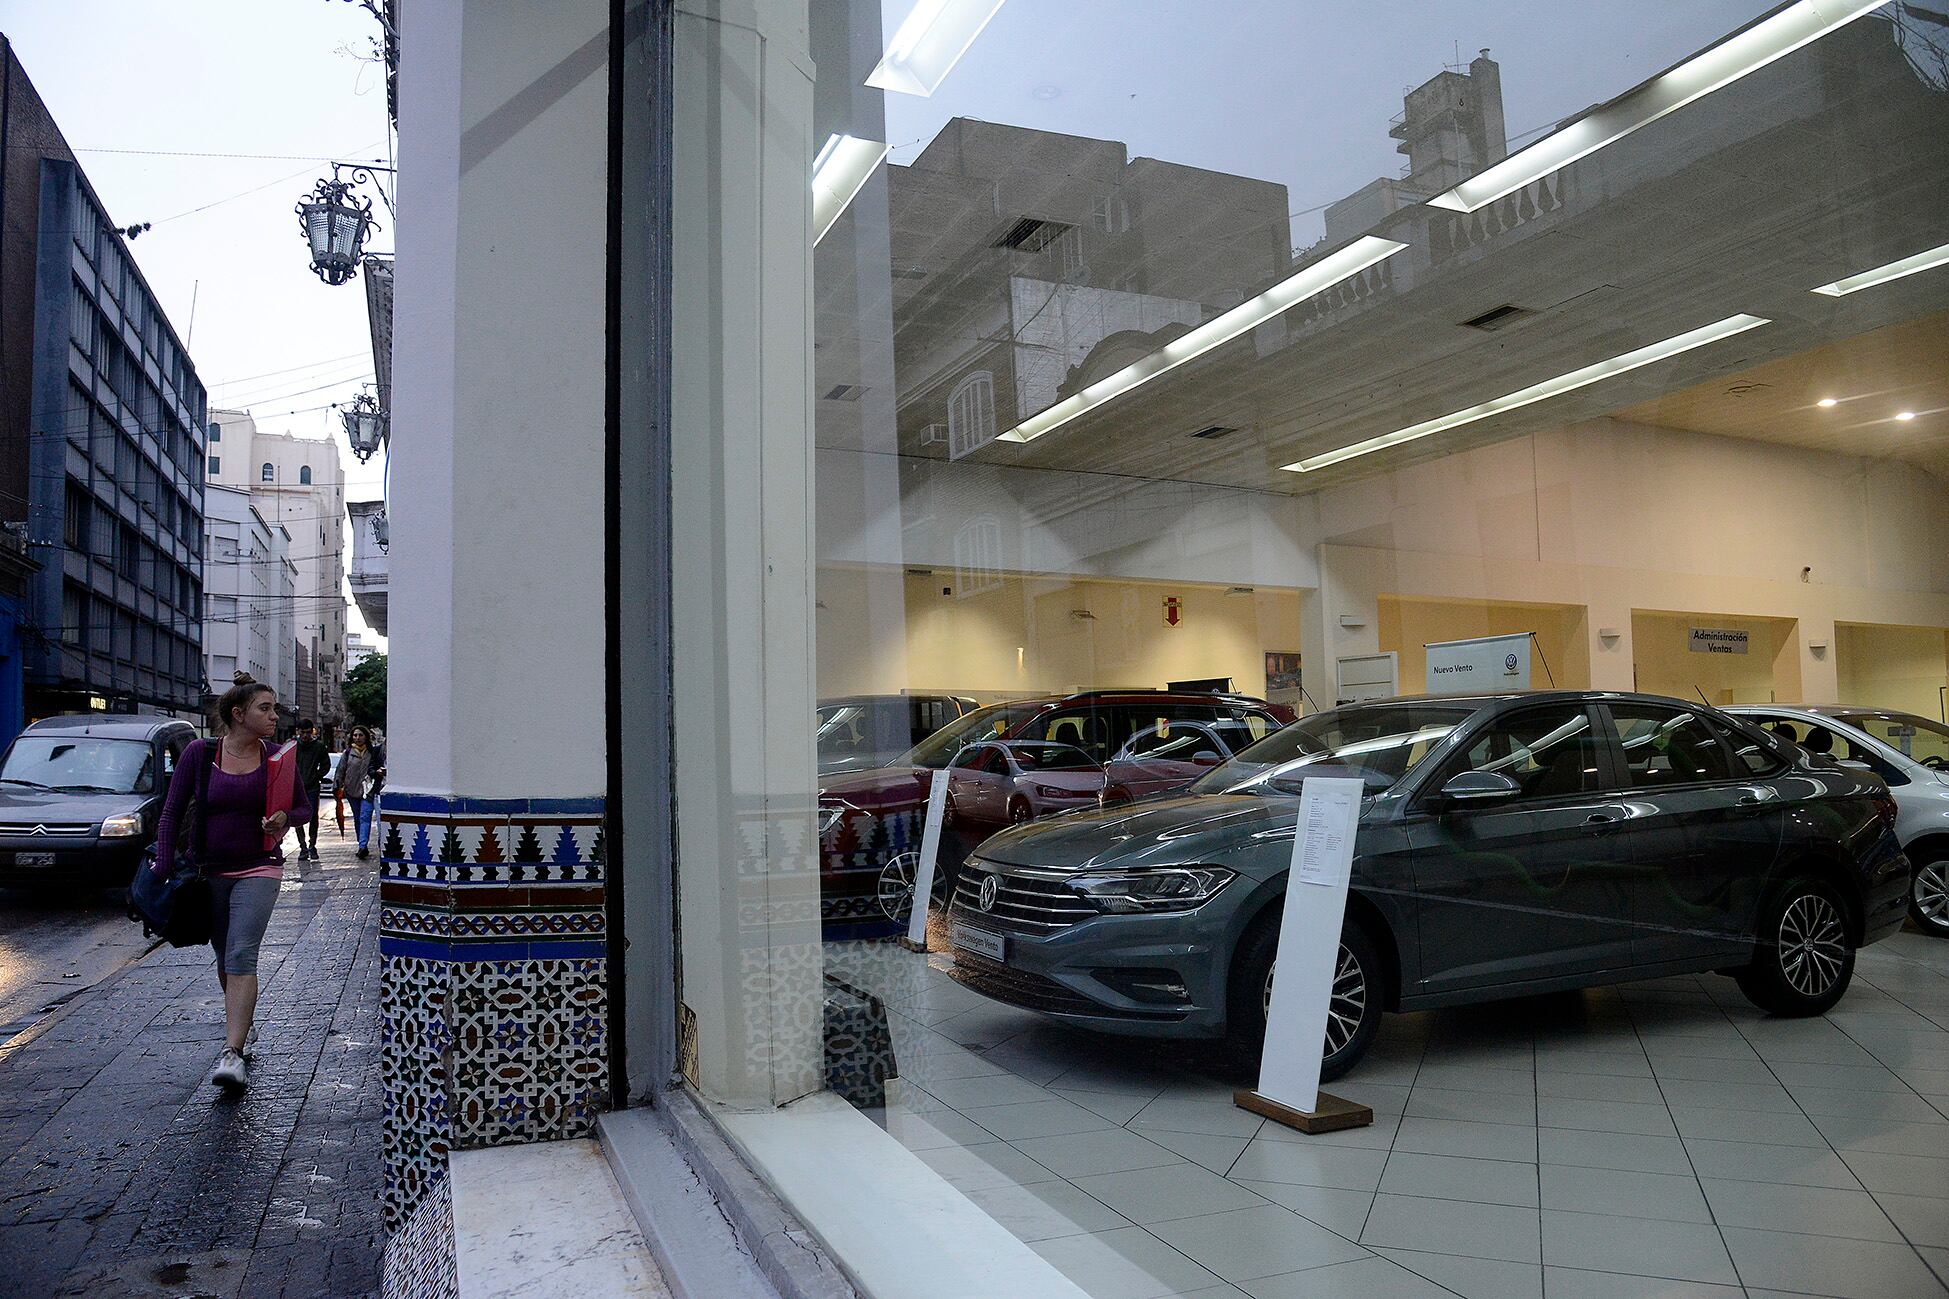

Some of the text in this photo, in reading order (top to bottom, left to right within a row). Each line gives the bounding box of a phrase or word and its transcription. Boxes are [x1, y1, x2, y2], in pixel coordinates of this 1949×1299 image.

[1708, 643, 1733, 653] Ventas
[1433, 664, 1473, 674] Nuevo Vento
